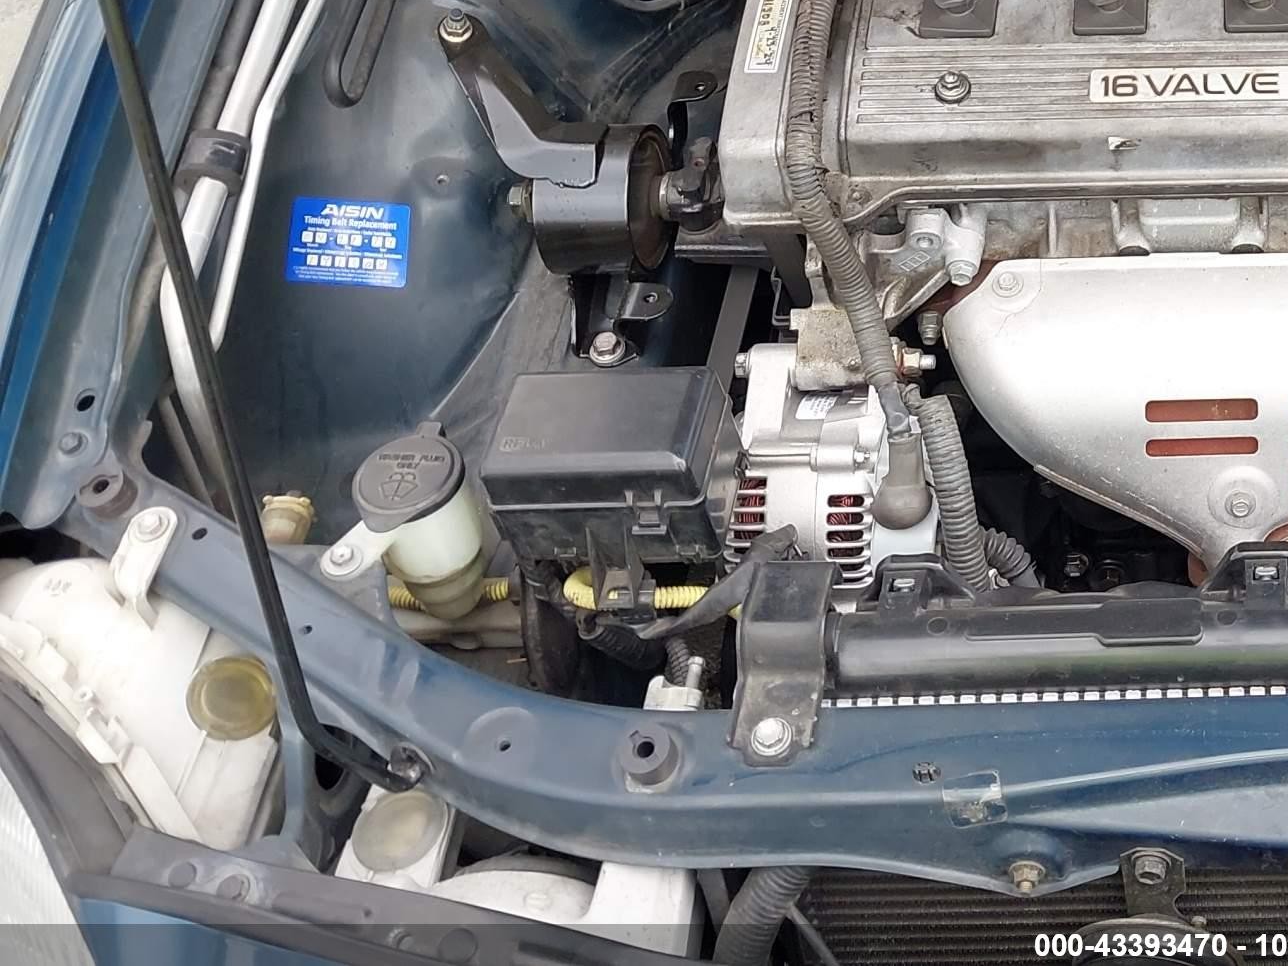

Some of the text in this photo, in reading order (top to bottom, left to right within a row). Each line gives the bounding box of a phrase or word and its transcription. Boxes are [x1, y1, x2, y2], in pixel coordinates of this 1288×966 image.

[1100, 74, 1138, 96] 16
[1144, 72, 1280, 96] VALVE
[321, 204, 384, 220] AISIN
[304, 216, 398, 230] Timing Belt Replacement
